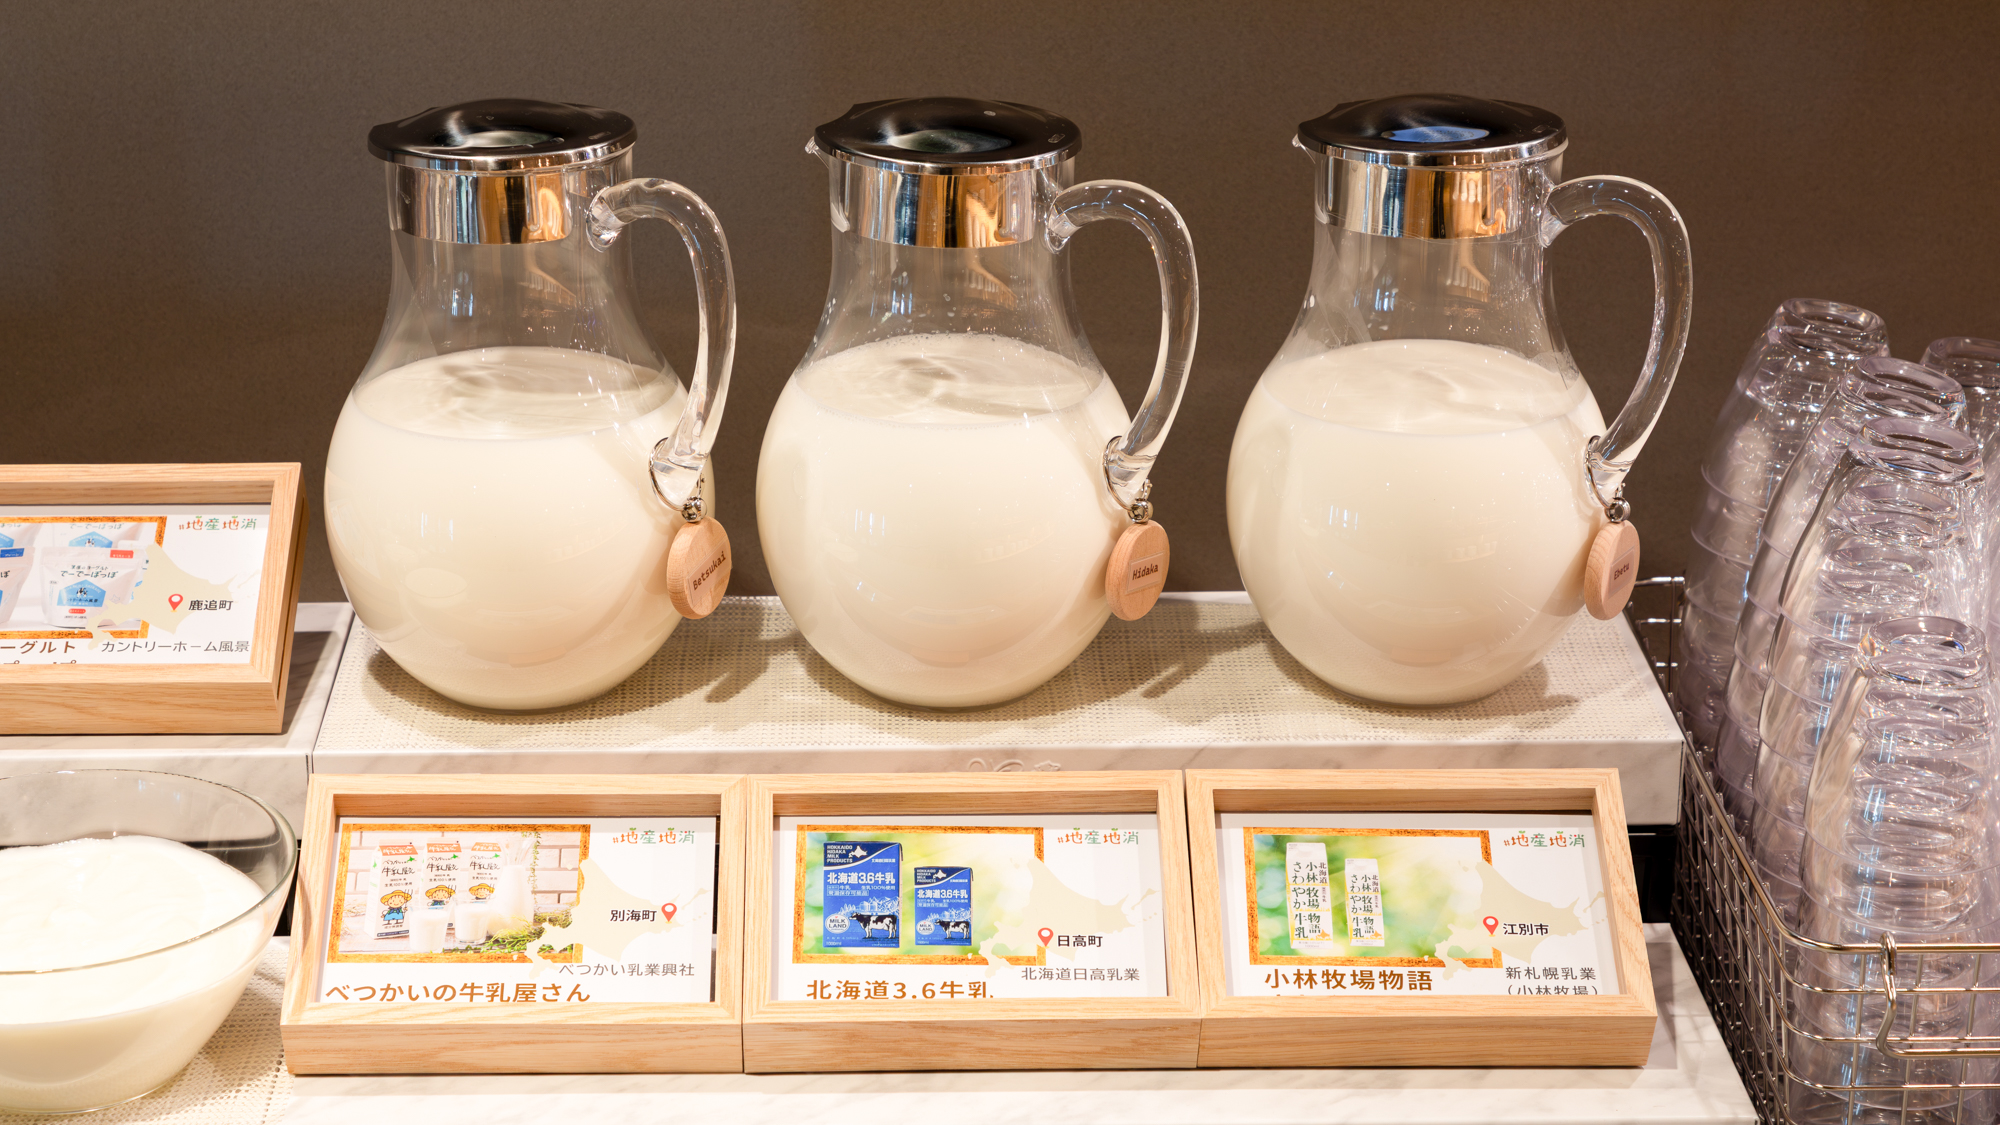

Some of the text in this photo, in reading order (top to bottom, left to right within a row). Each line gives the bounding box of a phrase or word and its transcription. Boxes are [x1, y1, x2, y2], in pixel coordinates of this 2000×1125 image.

[692, 551, 727, 591] Betsukai
[1132, 563, 1159, 581] Hidaka
[1613, 562, 1630, 581] Ebetu
[188, 599, 234, 611] 鹿追町
[101, 640, 250, 653] カントリーホーム風景
[827, 872, 896, 884] 北海道3.6牛乳
[1318, 862, 1328, 884] 北海道
[1371, 874, 1380, 893] 北海道
[917, 889, 968, 899] 北海道3.6牛乳
[610, 908, 657, 922] 別海町
[1502, 922, 1549, 936] 江別市
[1056, 934, 1103, 948] 日高町
[559, 963, 695, 977] べつかい乳業興社
[1021, 967, 1140, 981] 北海道日高乳業
[1505, 966, 1596, 981] 新札幌乳業
[1264, 968, 1433, 991] 小林牧場物語
[325, 982, 591, 1002] べつかいの牛乳屋さん
[806, 979, 994, 999] 北海道3.6牛乳
